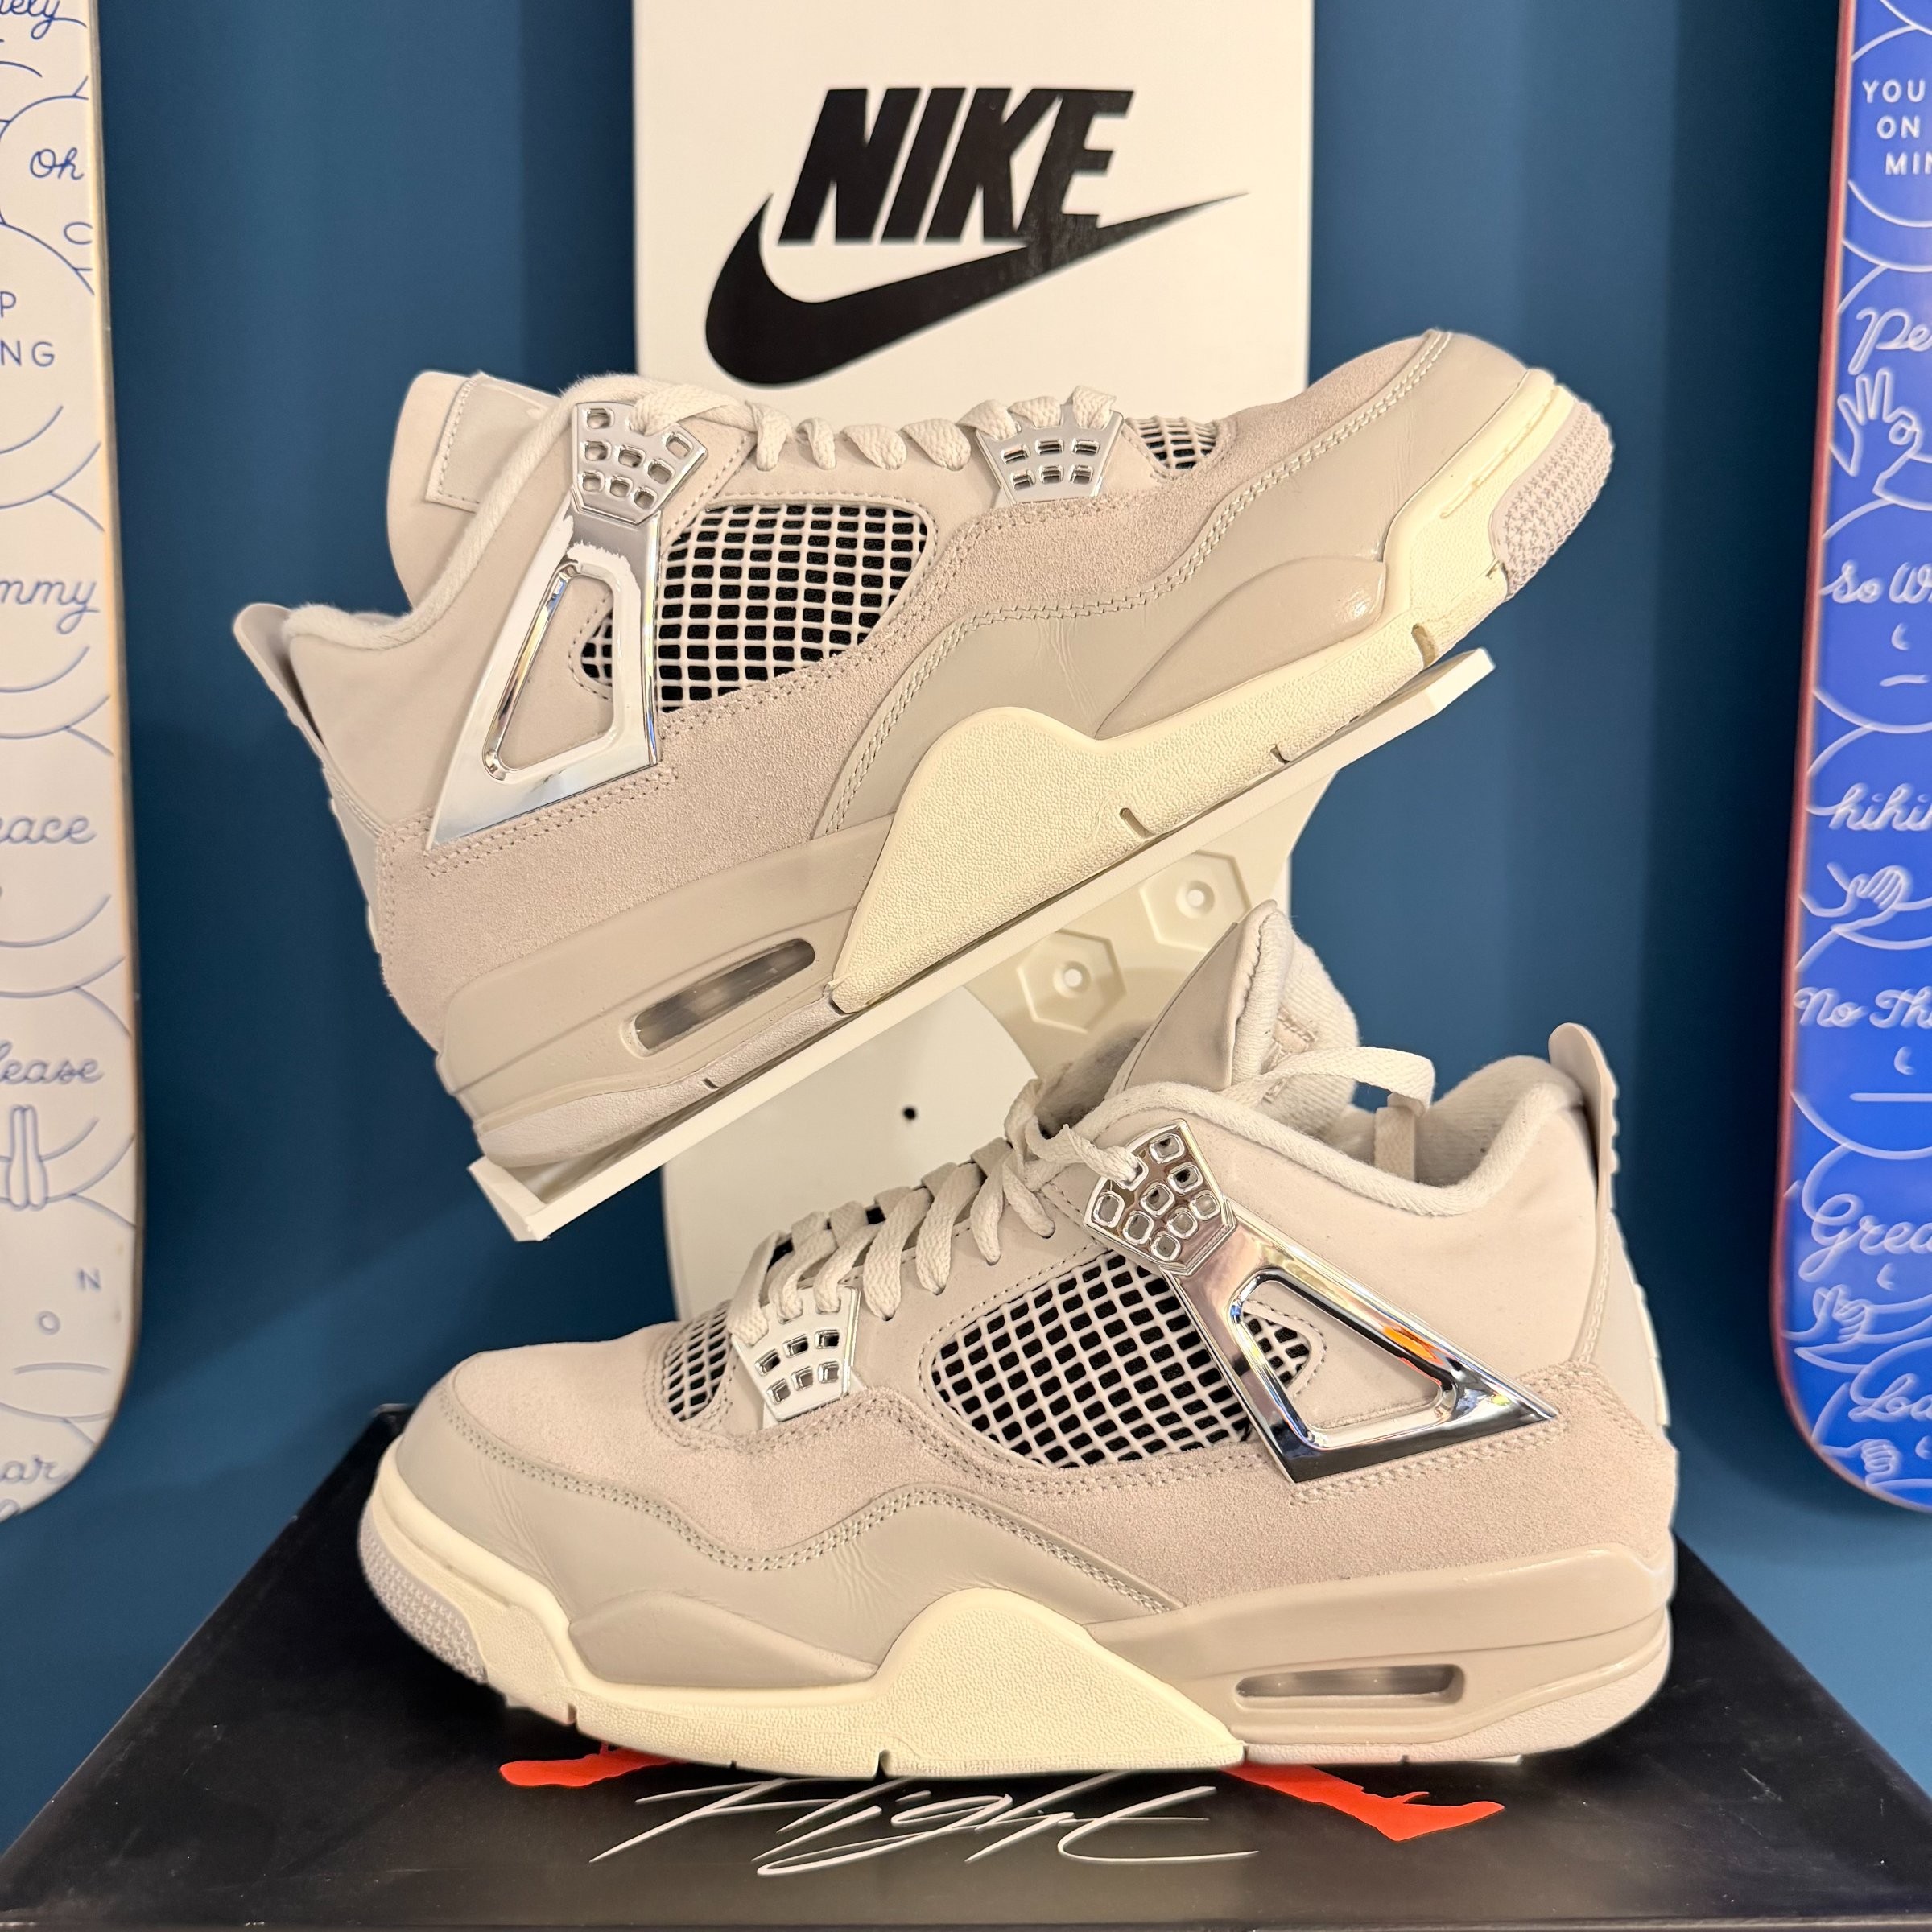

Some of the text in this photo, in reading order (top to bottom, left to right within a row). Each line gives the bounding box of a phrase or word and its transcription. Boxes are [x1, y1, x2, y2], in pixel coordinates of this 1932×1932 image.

[1862, 79, 1926, 103] YOU
[1876, 115, 1920, 139] ON
[30, 147, 84, 180] Oh
[778, 88, 1134, 246] NIKE
[1793, 986, 1868, 1027] No
